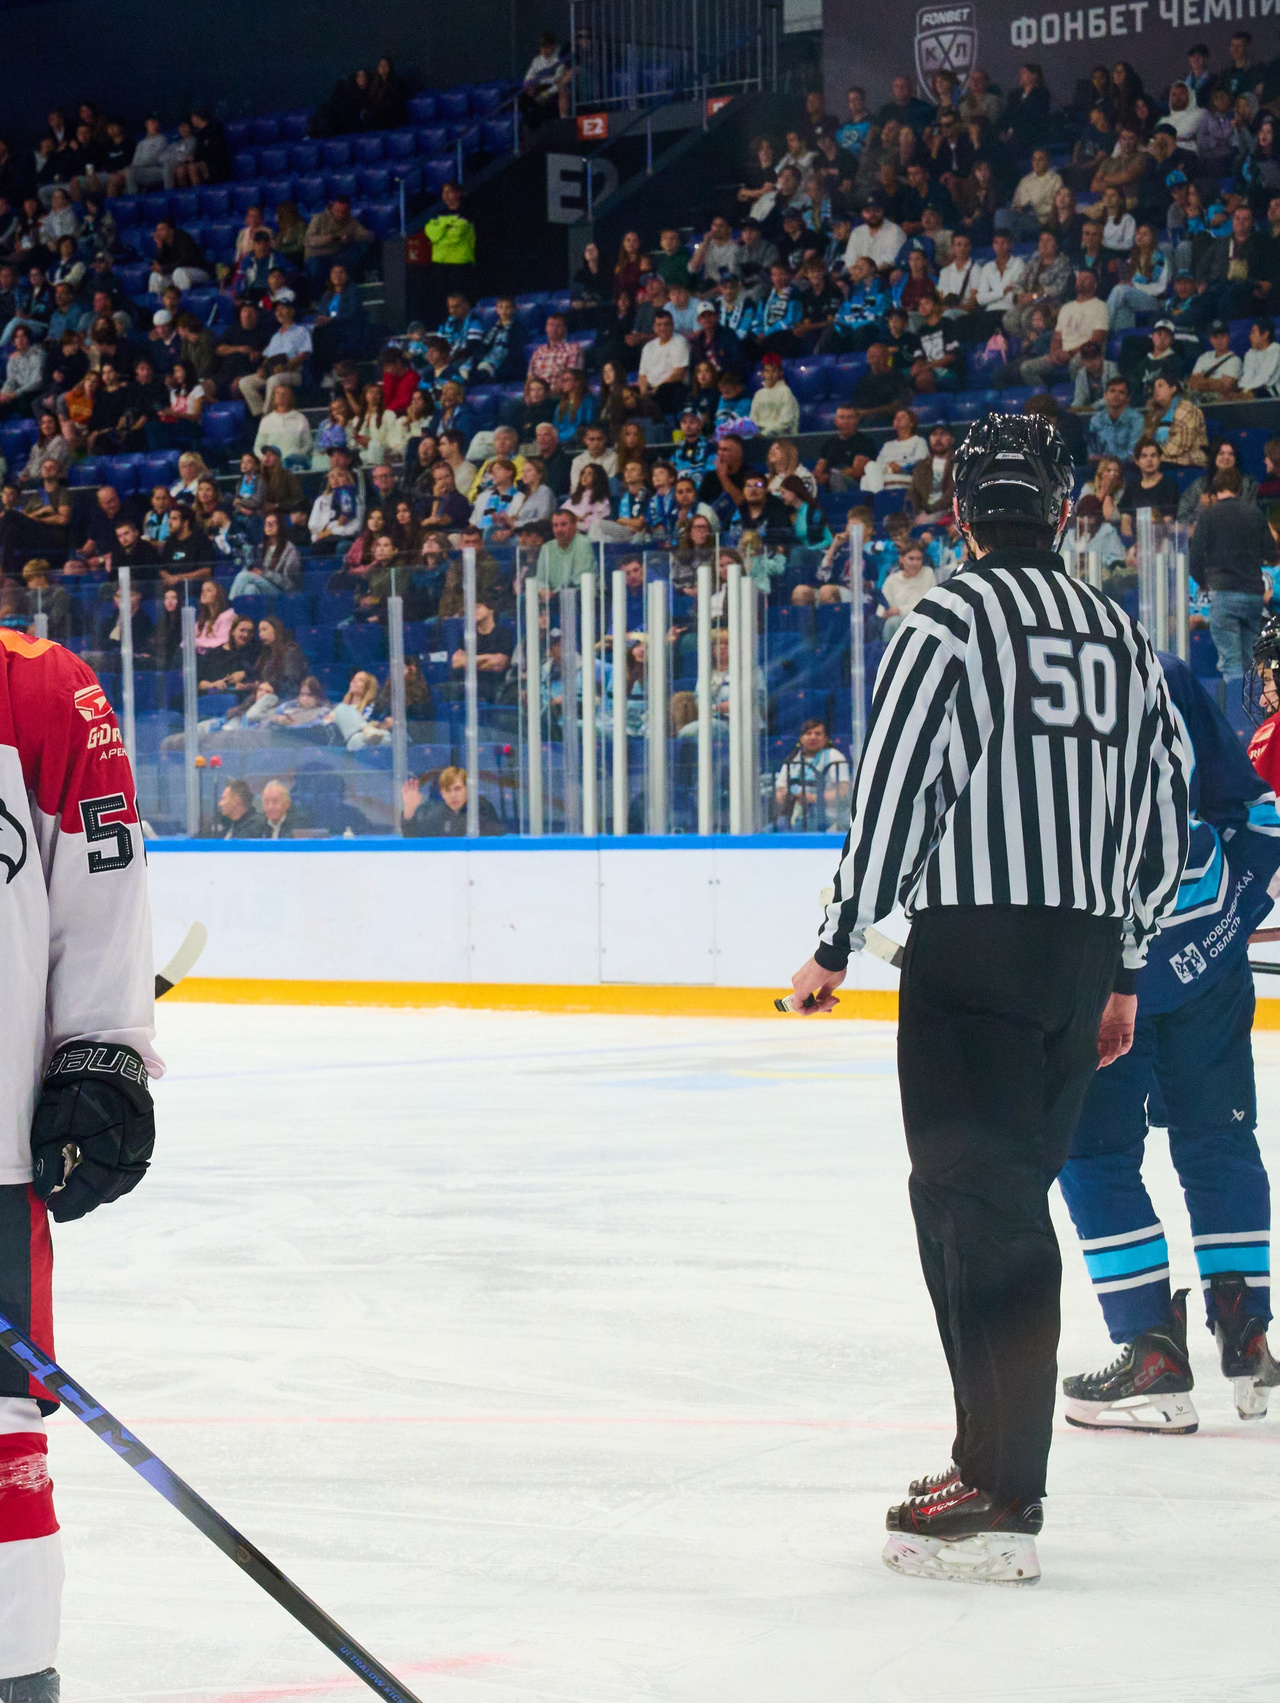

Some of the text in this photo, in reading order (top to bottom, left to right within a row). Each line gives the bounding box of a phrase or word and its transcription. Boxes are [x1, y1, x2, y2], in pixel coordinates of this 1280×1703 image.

[922, 8, 970, 25] FONBET
[1010, 3, 1149, 48] ФОНБЕТ
[582, 117, 604, 136] E2
[1026, 635, 1117, 735] 50
[78, 791, 147, 875] 5
[1209, 916, 1240, 958] ОБЛАСТЬ
[1121, 1356, 1166, 1397] CCM
